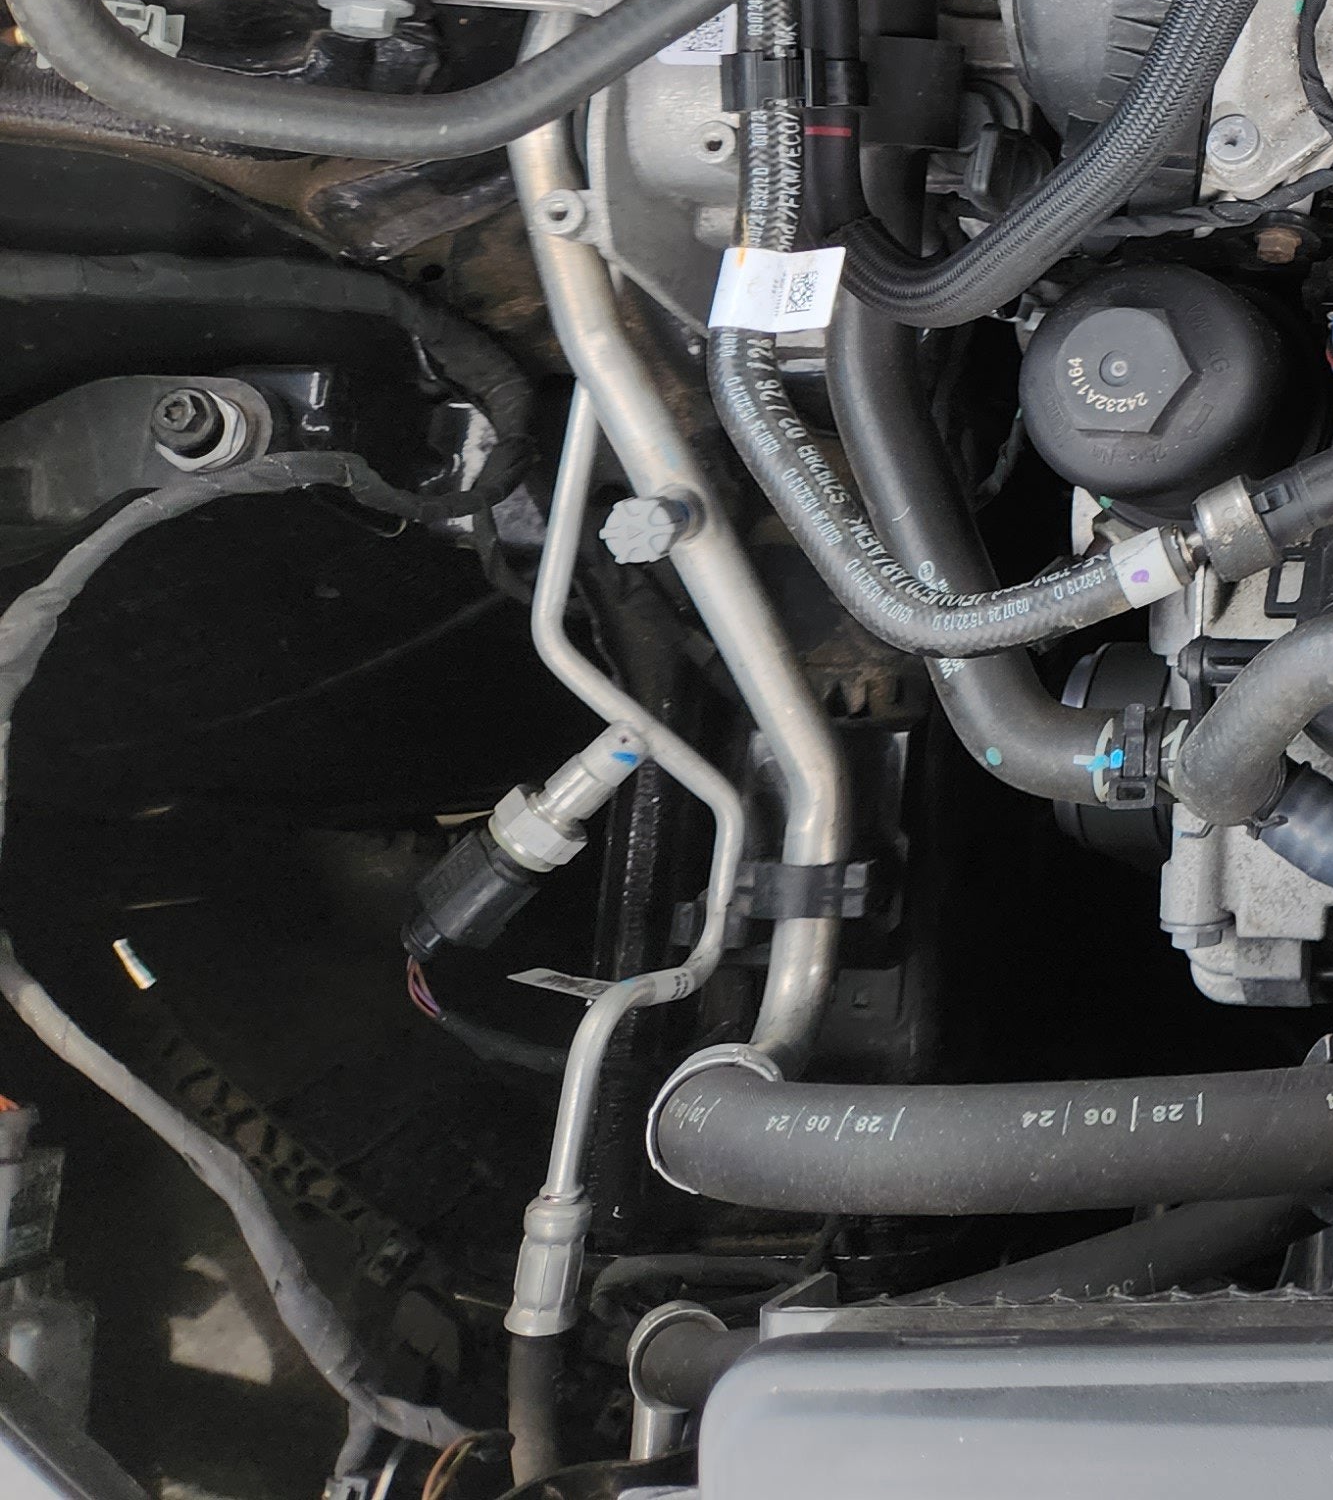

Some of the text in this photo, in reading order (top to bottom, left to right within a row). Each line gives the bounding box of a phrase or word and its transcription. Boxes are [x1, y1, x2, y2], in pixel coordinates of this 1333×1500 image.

[755, 379, 784, 401] 26
[1067, 356, 1148, 412] 24232A1164
[778, 417, 807, 441] 02
[765, 1114, 883, 1133] 28 06 24
[1021, 1104, 1184, 1129] 28 06 24
